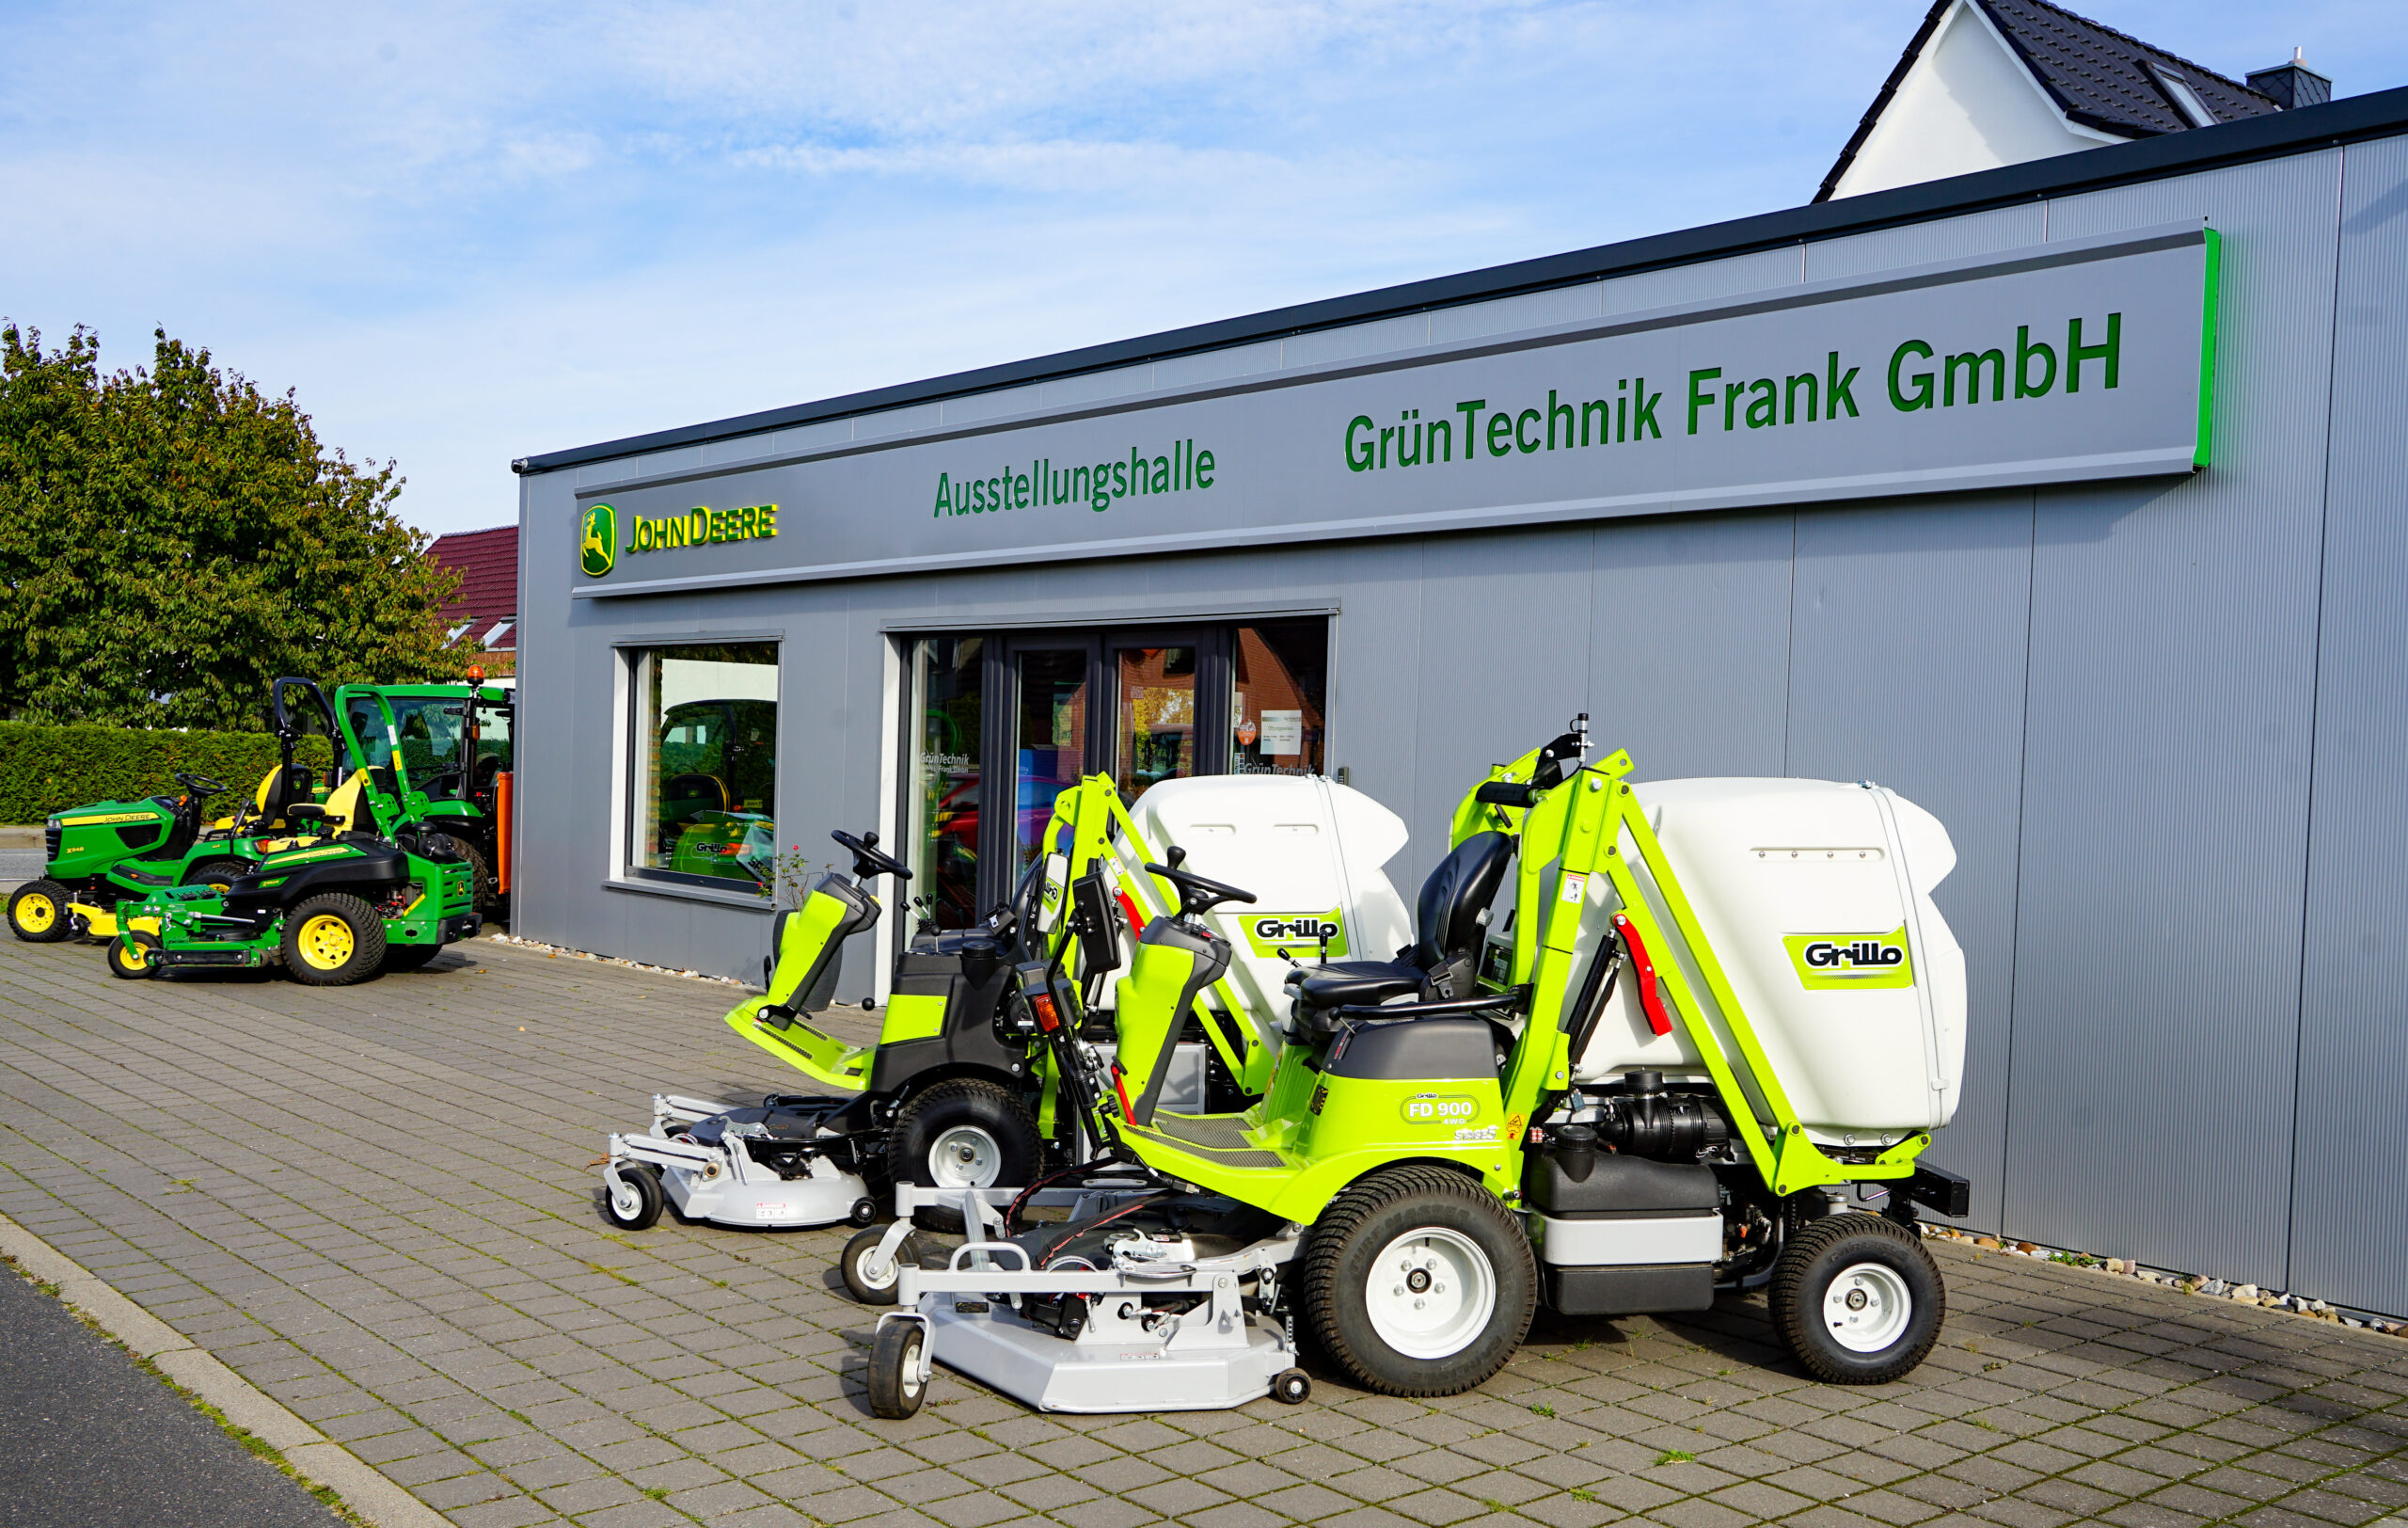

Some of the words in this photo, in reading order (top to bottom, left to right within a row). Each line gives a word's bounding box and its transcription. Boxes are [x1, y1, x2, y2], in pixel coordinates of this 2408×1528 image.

[1344, 376, 1663, 472] GrünTechnik
[1687, 351, 1861, 436] Frank
[1887, 311, 2122, 412] GmbH
[934, 438, 1215, 517] Ausstellungshalle
[626, 515, 690, 553] JOHN
[690, 504, 779, 546] DEERE
[919, 752, 970, 765] GrünTechnik
[103, 815, 124, 823] JOHN
[124, 813, 150, 821] DEERE
[1256, 919, 1339, 938] Grillo
[1805, 942, 1903, 967] Grillo
[1409, 1103, 1434, 1118] FD
[1436, 1101, 1473, 1117] 900
